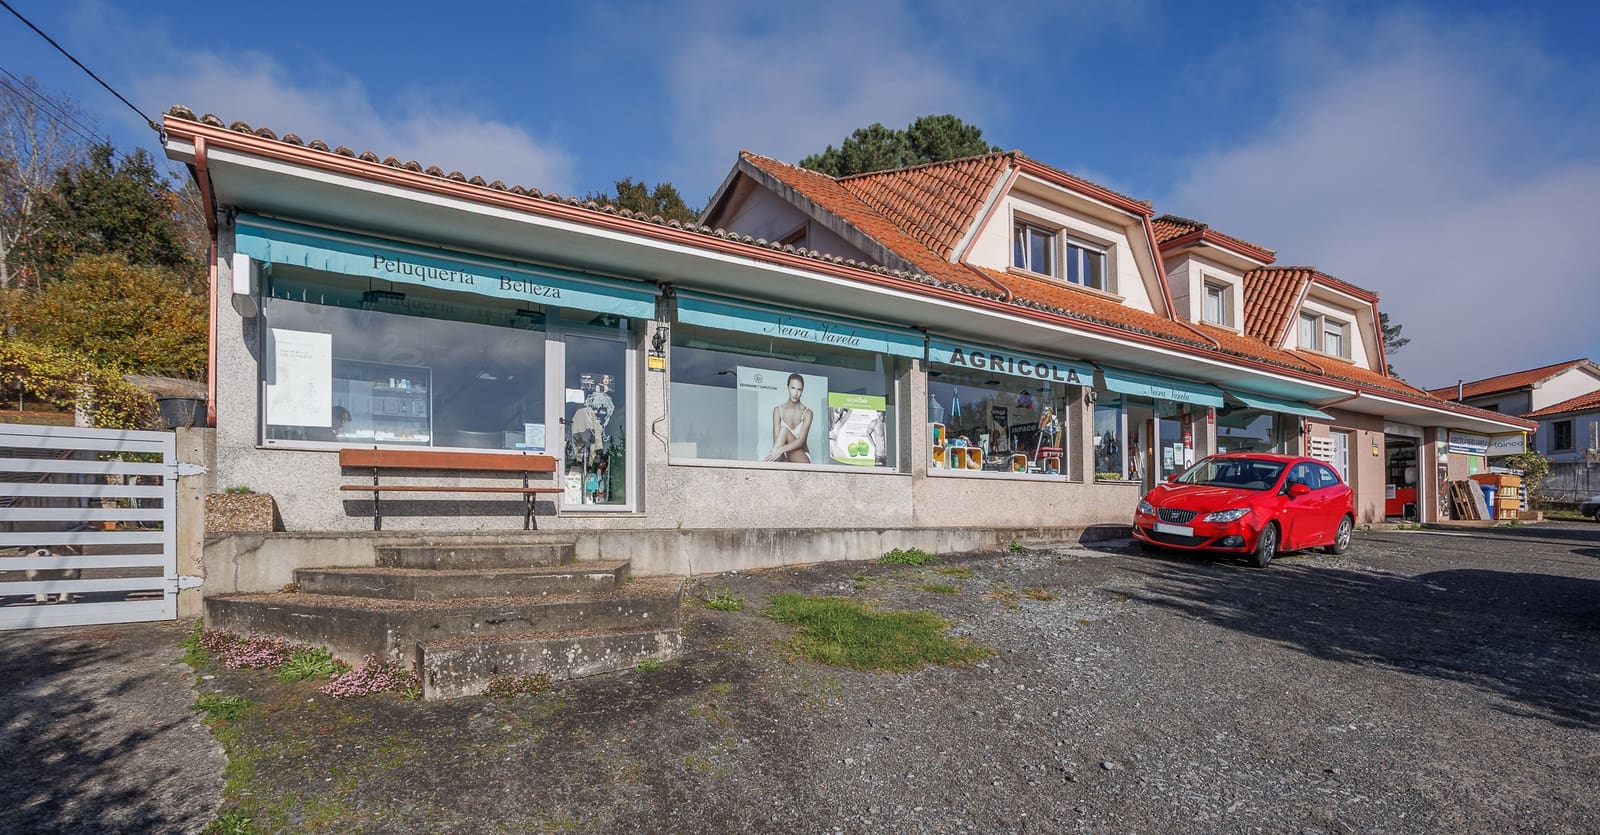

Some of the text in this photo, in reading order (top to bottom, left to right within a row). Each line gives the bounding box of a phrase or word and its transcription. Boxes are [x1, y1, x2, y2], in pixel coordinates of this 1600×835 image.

[372, 254, 562, 299] Peluquería Belleza
[763, 316, 861, 345] Neira Varela
[949, 347, 1081, 384] AGRICOLA
